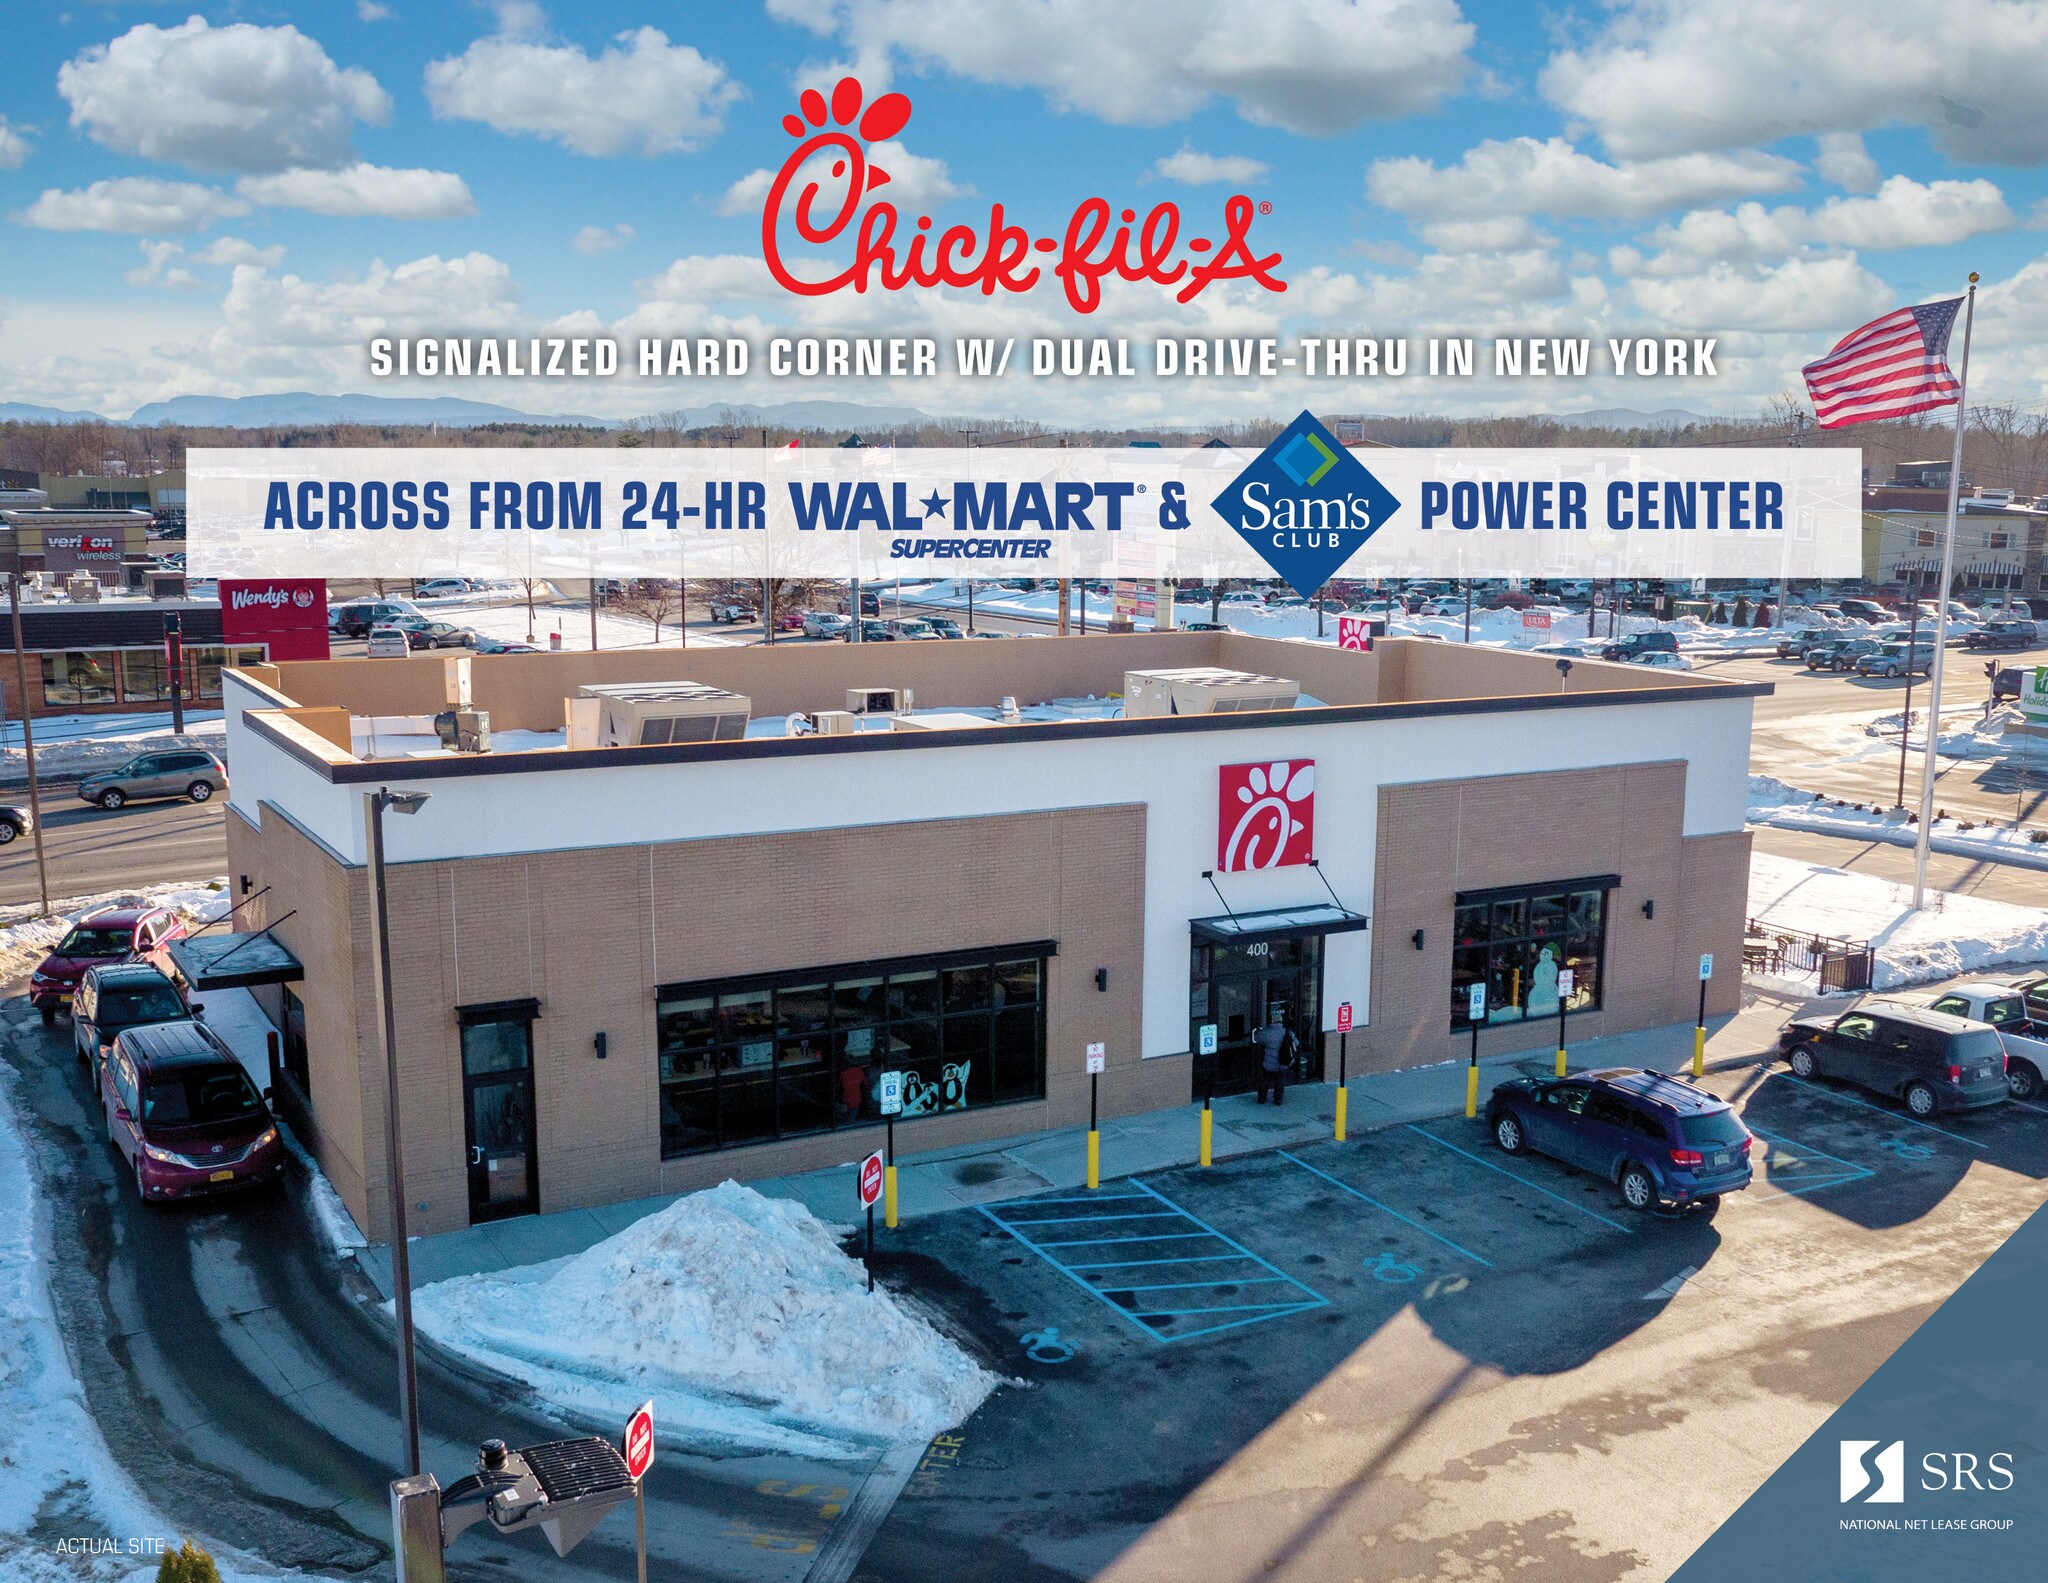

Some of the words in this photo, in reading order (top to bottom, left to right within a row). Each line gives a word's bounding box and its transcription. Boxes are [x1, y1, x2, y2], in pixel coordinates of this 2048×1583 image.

[48, 535, 113, 550] verizon
[77, 551, 121, 561] wireless
[231, 585, 289, 610] Wendy's
[1247, 942, 1268, 956] 400
